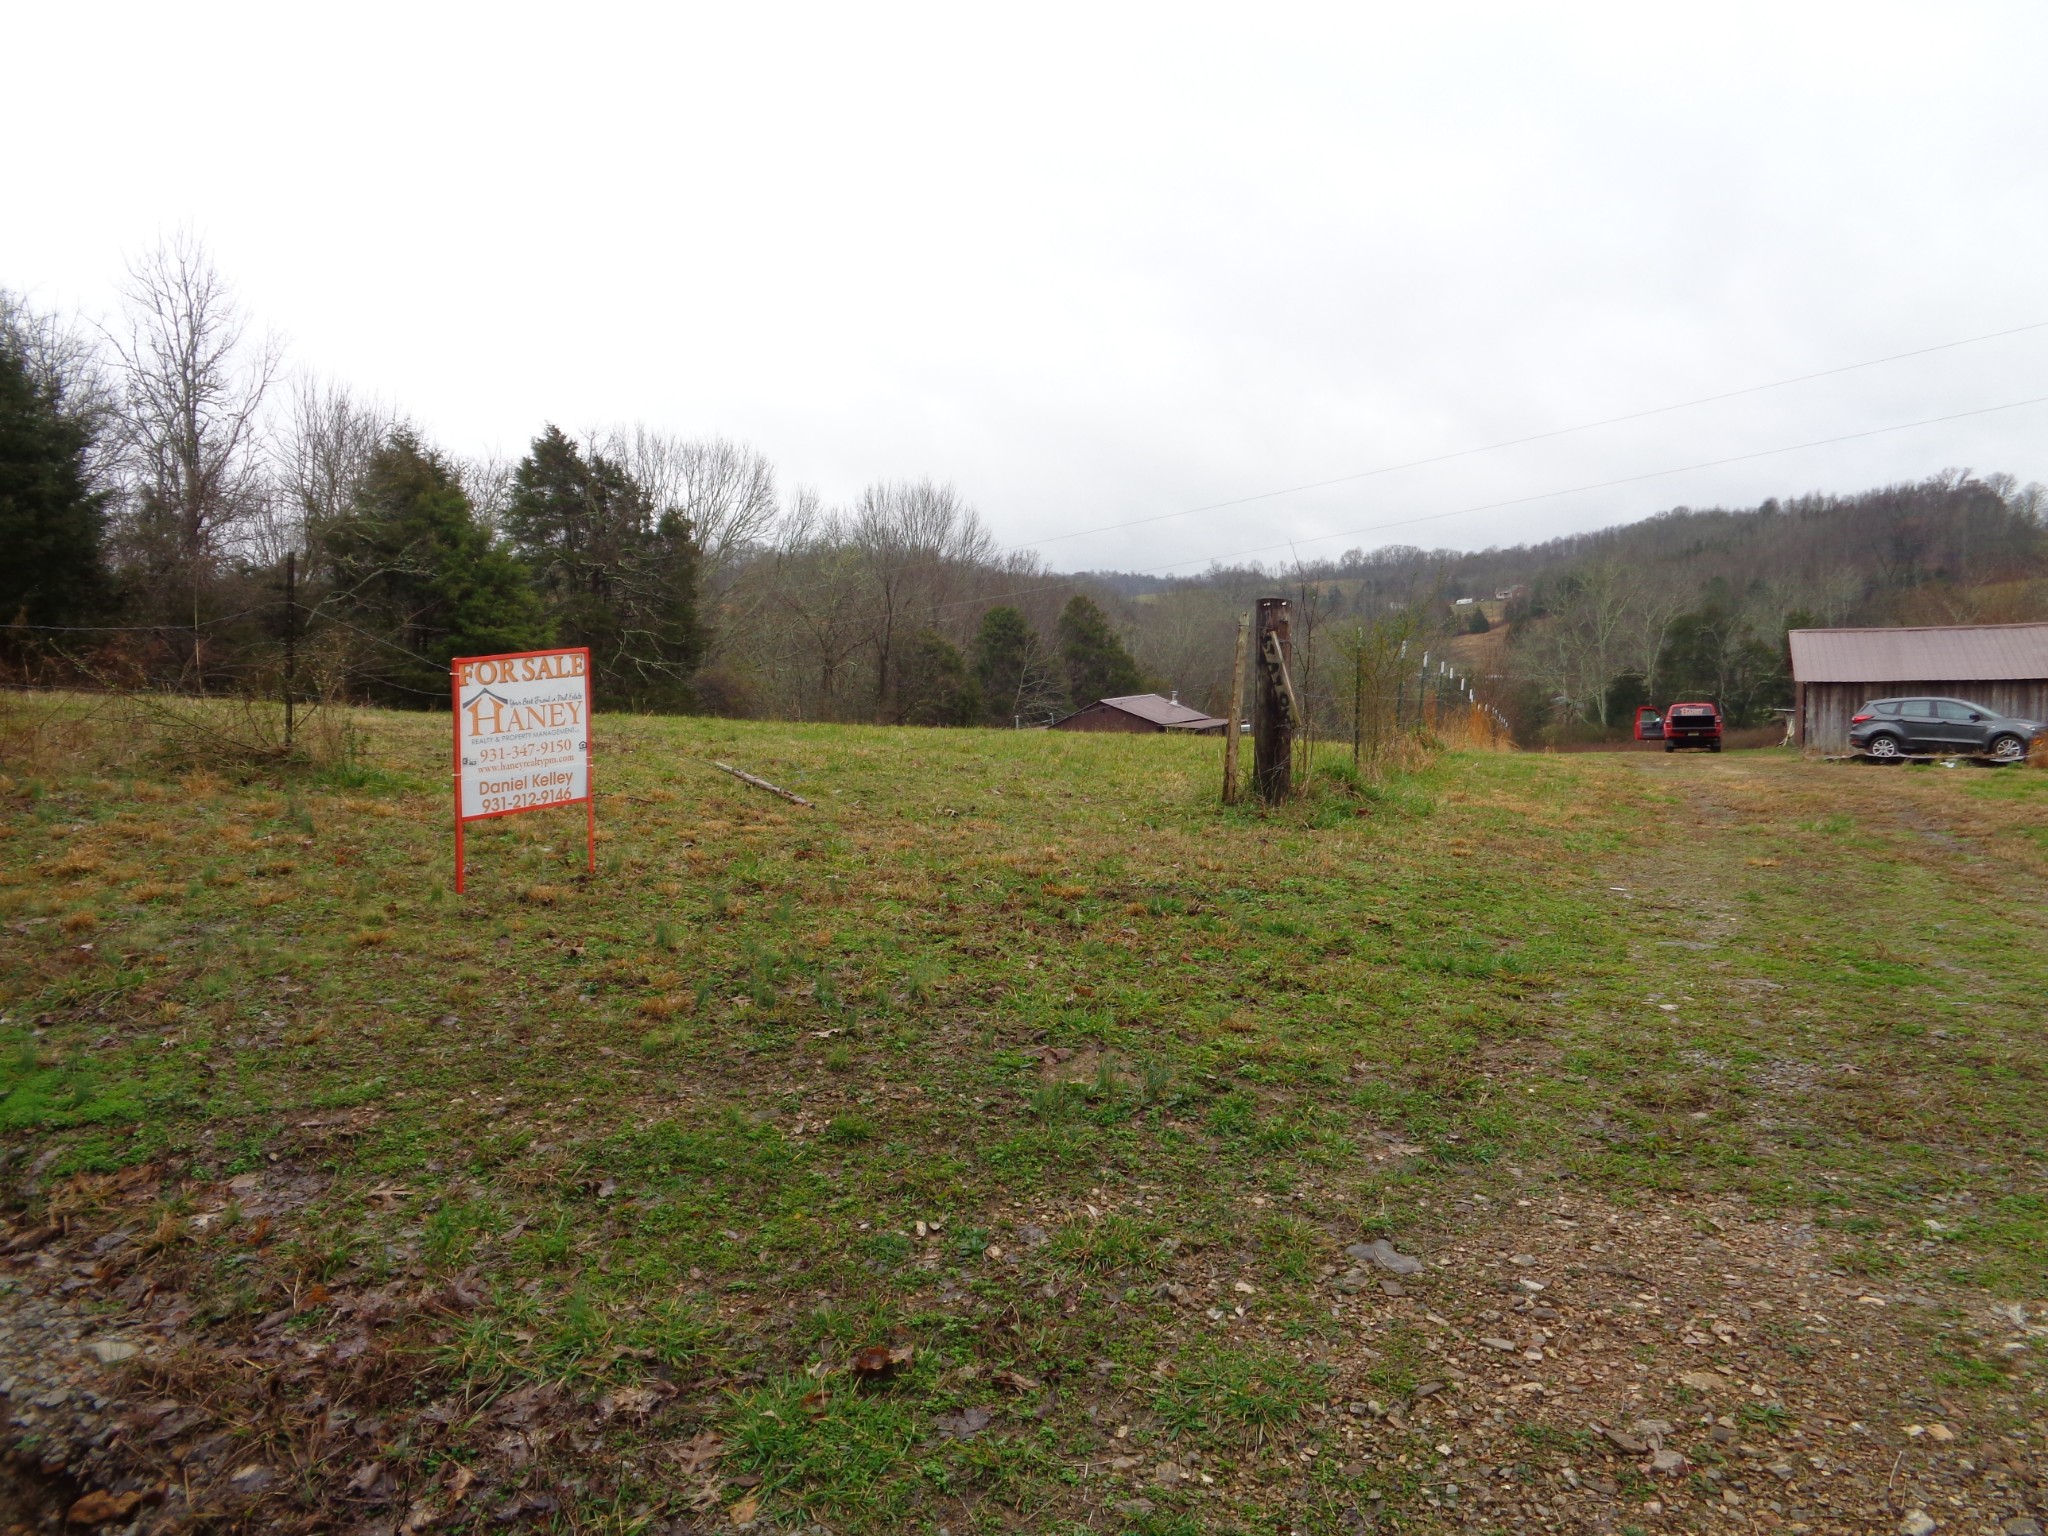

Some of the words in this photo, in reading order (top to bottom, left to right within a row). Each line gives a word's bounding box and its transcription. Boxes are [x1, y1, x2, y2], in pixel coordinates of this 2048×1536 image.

[459, 659, 518, 687] FOR
[521, 654, 585, 682] SALE
[467, 697, 583, 737] HANEY
[471, 737, 493, 746] REALTY
[501, 733, 532, 742] PROPERTY
[533, 728, 575, 738] MANAGEMENT
[480, 739, 572, 763] 931-347-9150
[478, 754, 574, 774] www.haneyrealtypm.com
[479, 776, 527, 796] Daniel
[532, 771, 574, 788] Kelley
[482, 787, 572, 813] 931-212-9146
